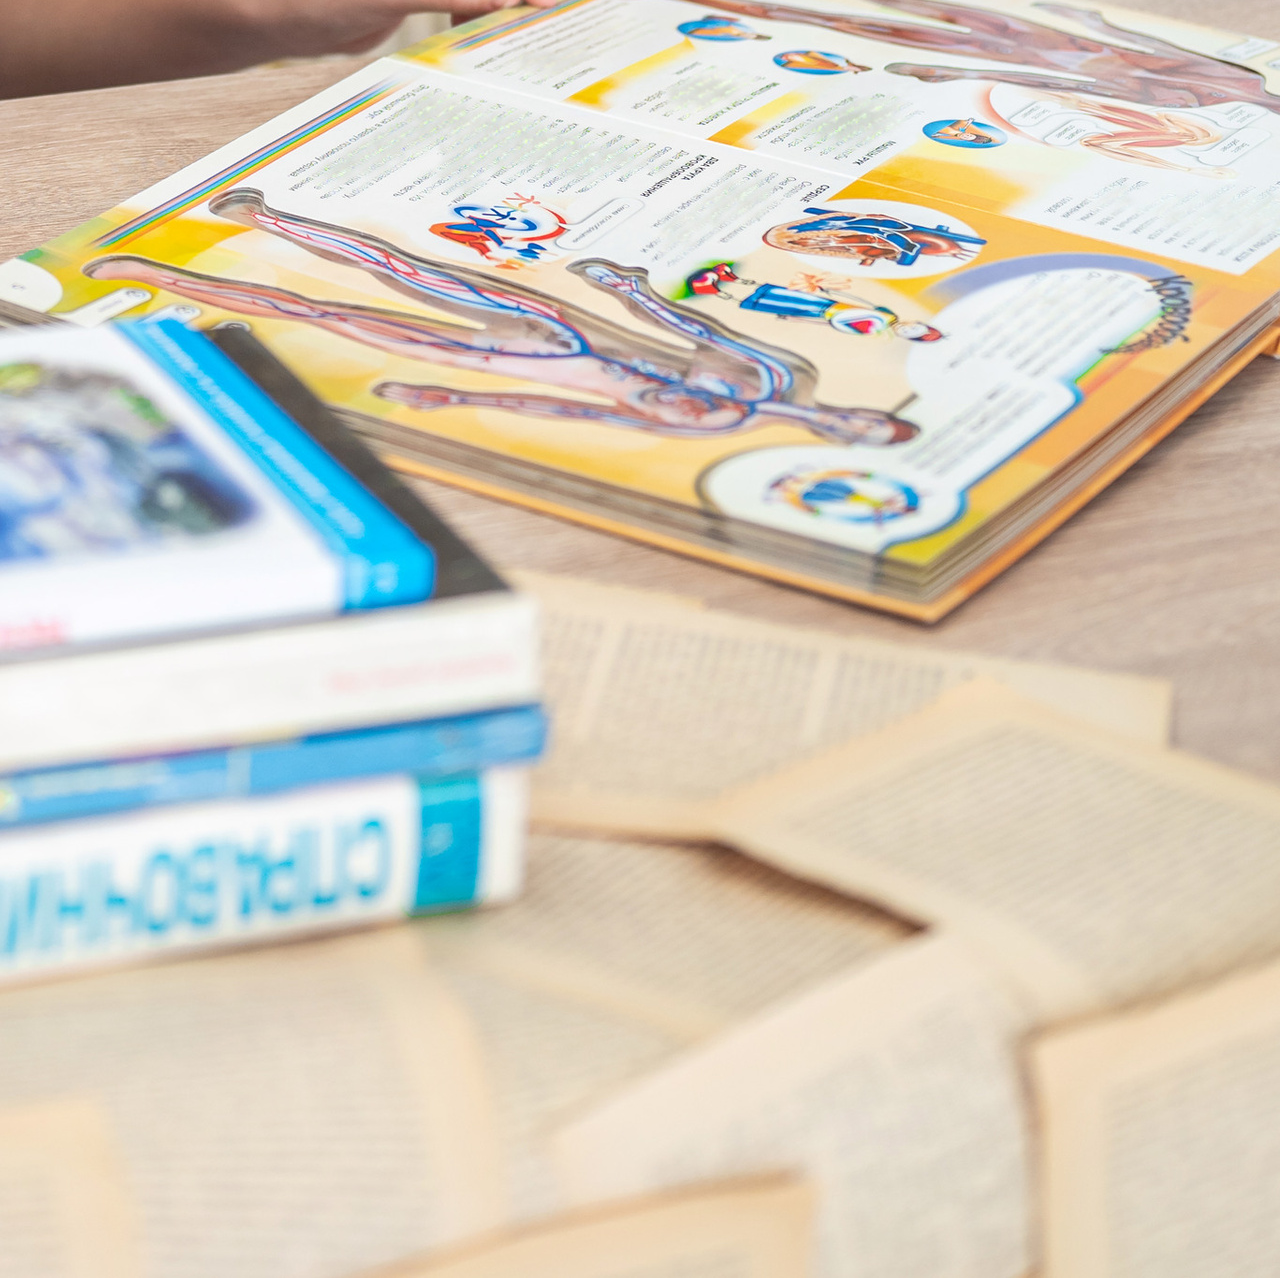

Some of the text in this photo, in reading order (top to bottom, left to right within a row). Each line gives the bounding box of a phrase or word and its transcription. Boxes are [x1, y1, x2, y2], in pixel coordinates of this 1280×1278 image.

[638, 155, 707, 195] КРОВООБРАЩЕНИЯ
[680, 157, 719, 180] ДВА КРУГА
[799, 185, 829, 202] СЕРДЦЕ
